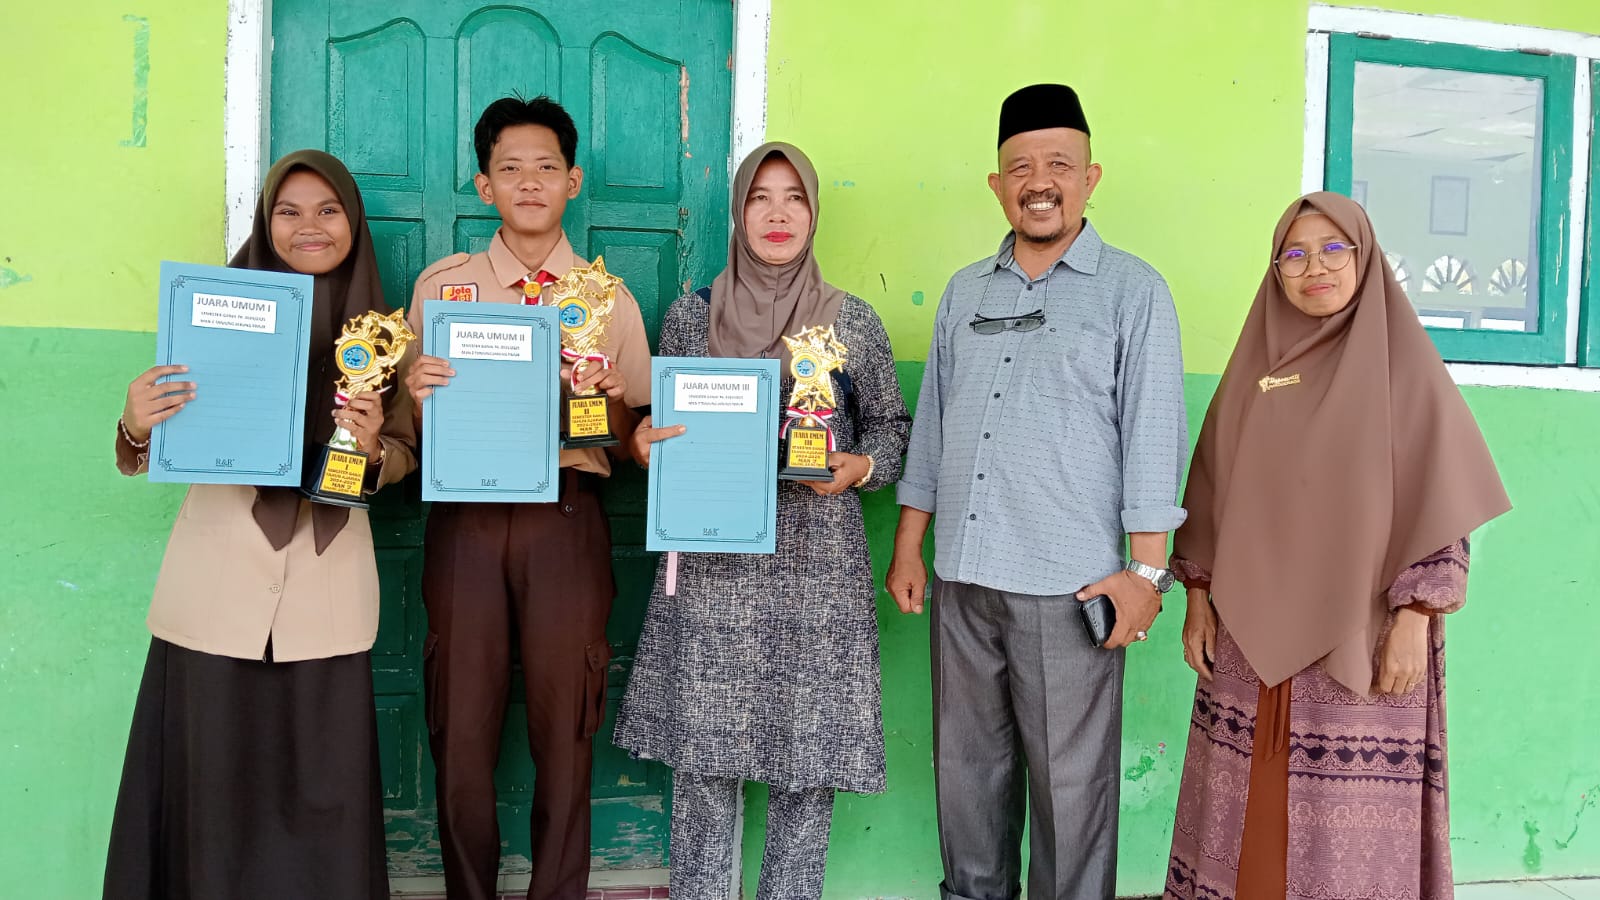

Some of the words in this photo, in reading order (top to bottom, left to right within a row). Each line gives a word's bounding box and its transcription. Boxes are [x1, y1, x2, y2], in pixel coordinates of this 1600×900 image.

[196, 297, 229, 308] JUARA
[231, 300, 266, 312] UMUM
[267, 304, 271, 312] I
[456, 331, 485, 340] JUARA
[487, 332, 518, 341] UMUM
[519, 334, 525, 342] II
[682, 382, 709, 390] JUARA
[711, 383, 740, 391] UMUM
